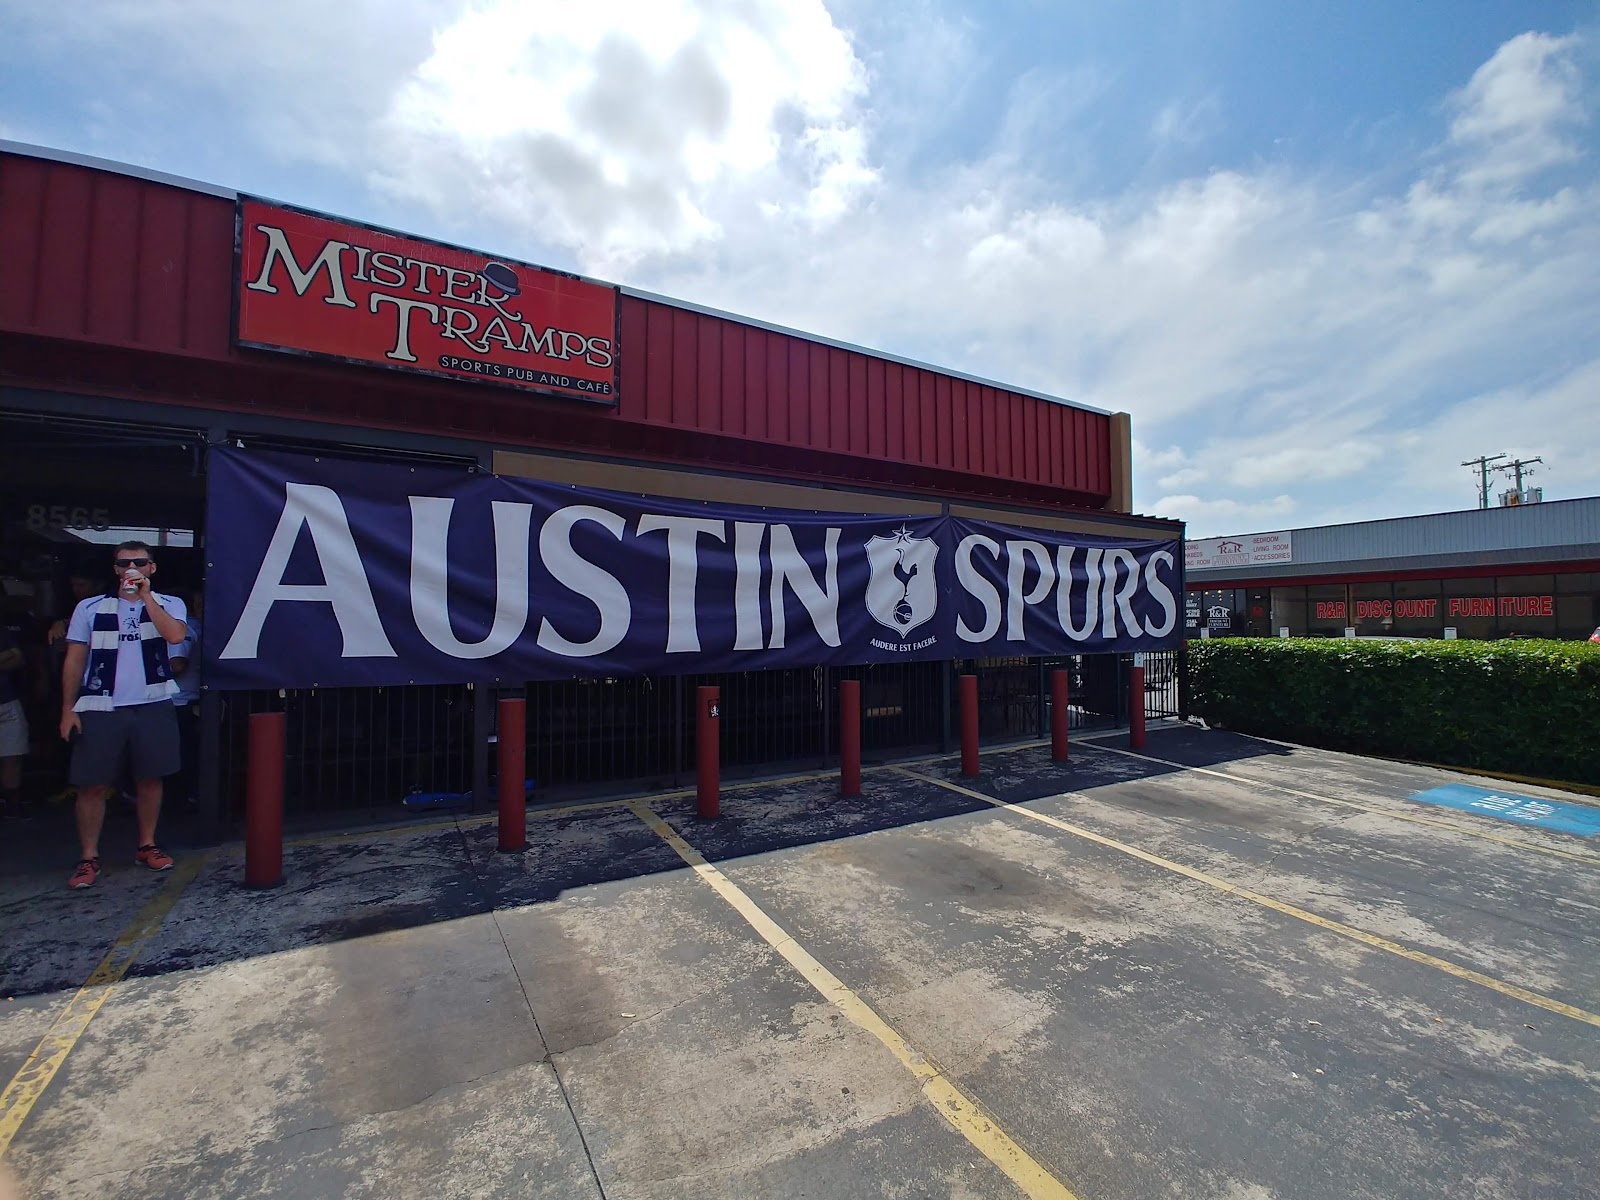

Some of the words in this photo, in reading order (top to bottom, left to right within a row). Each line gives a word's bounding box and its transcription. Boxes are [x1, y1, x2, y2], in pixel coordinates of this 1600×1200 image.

[247, 225, 521, 320] MISTER
[370, 292, 613, 368] TRAMPS
[441, 356, 501, 376] SPORTS
[507, 367, 534, 381] PUB
[539, 373, 570, 388] AND
[577, 379, 610, 395] CAFÉ
[27, 504, 110, 531] 8565
[1219, 544, 1242, 554] R&R
[1272, 543, 1289, 551] ROOM
[219, 481, 842, 660] AUSTIN
[954, 534, 1177, 646] SPURS
[1208, 609, 1229, 618] R&R
[1316, 601, 1346, 619] R&R
[869, 637, 898, 652] AUDERE
[899, 643, 912, 652] EST
[913, 635, 938, 651] FACERE
